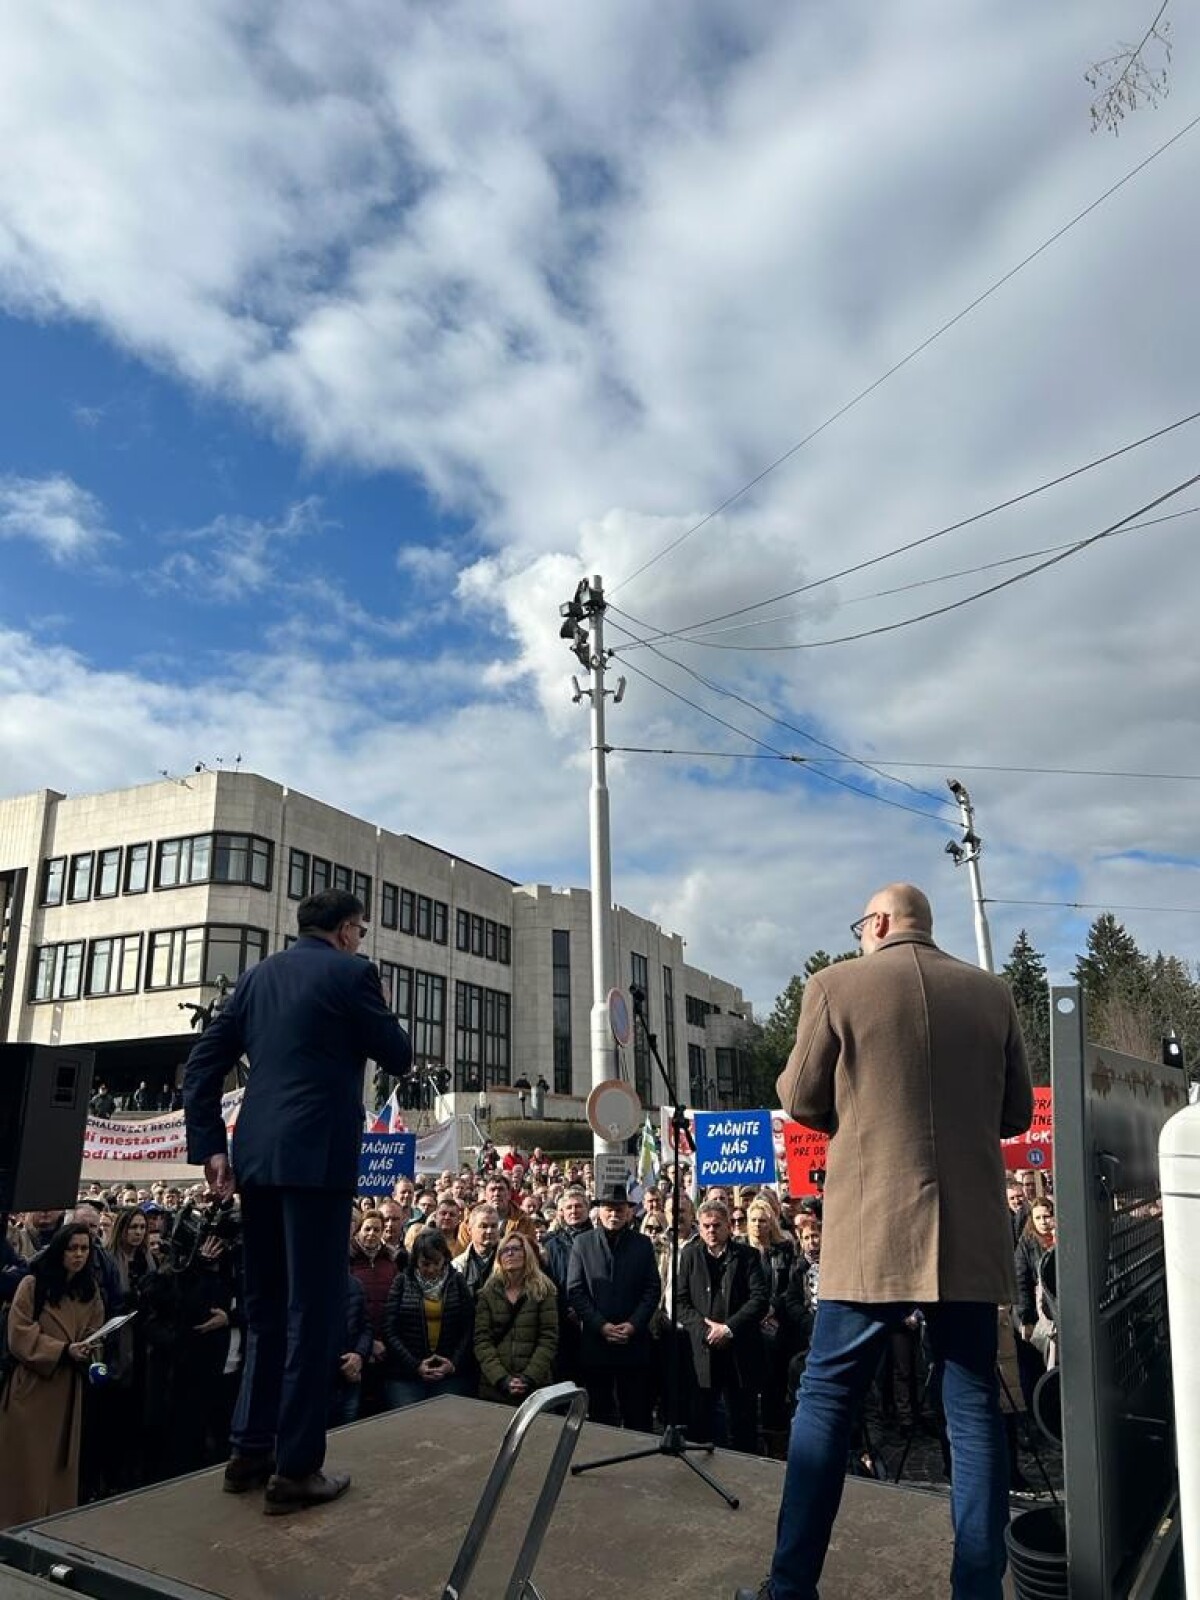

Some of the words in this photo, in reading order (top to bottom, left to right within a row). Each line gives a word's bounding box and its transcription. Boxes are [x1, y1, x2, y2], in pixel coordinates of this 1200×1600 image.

[707, 1119, 760, 1137] ZAČNITE
[789, 1133, 803, 1144] MY
[720, 1139, 749, 1156] NÁS
[793, 1147, 810, 1157] PRE
[368, 1156, 395, 1170] NÁS
